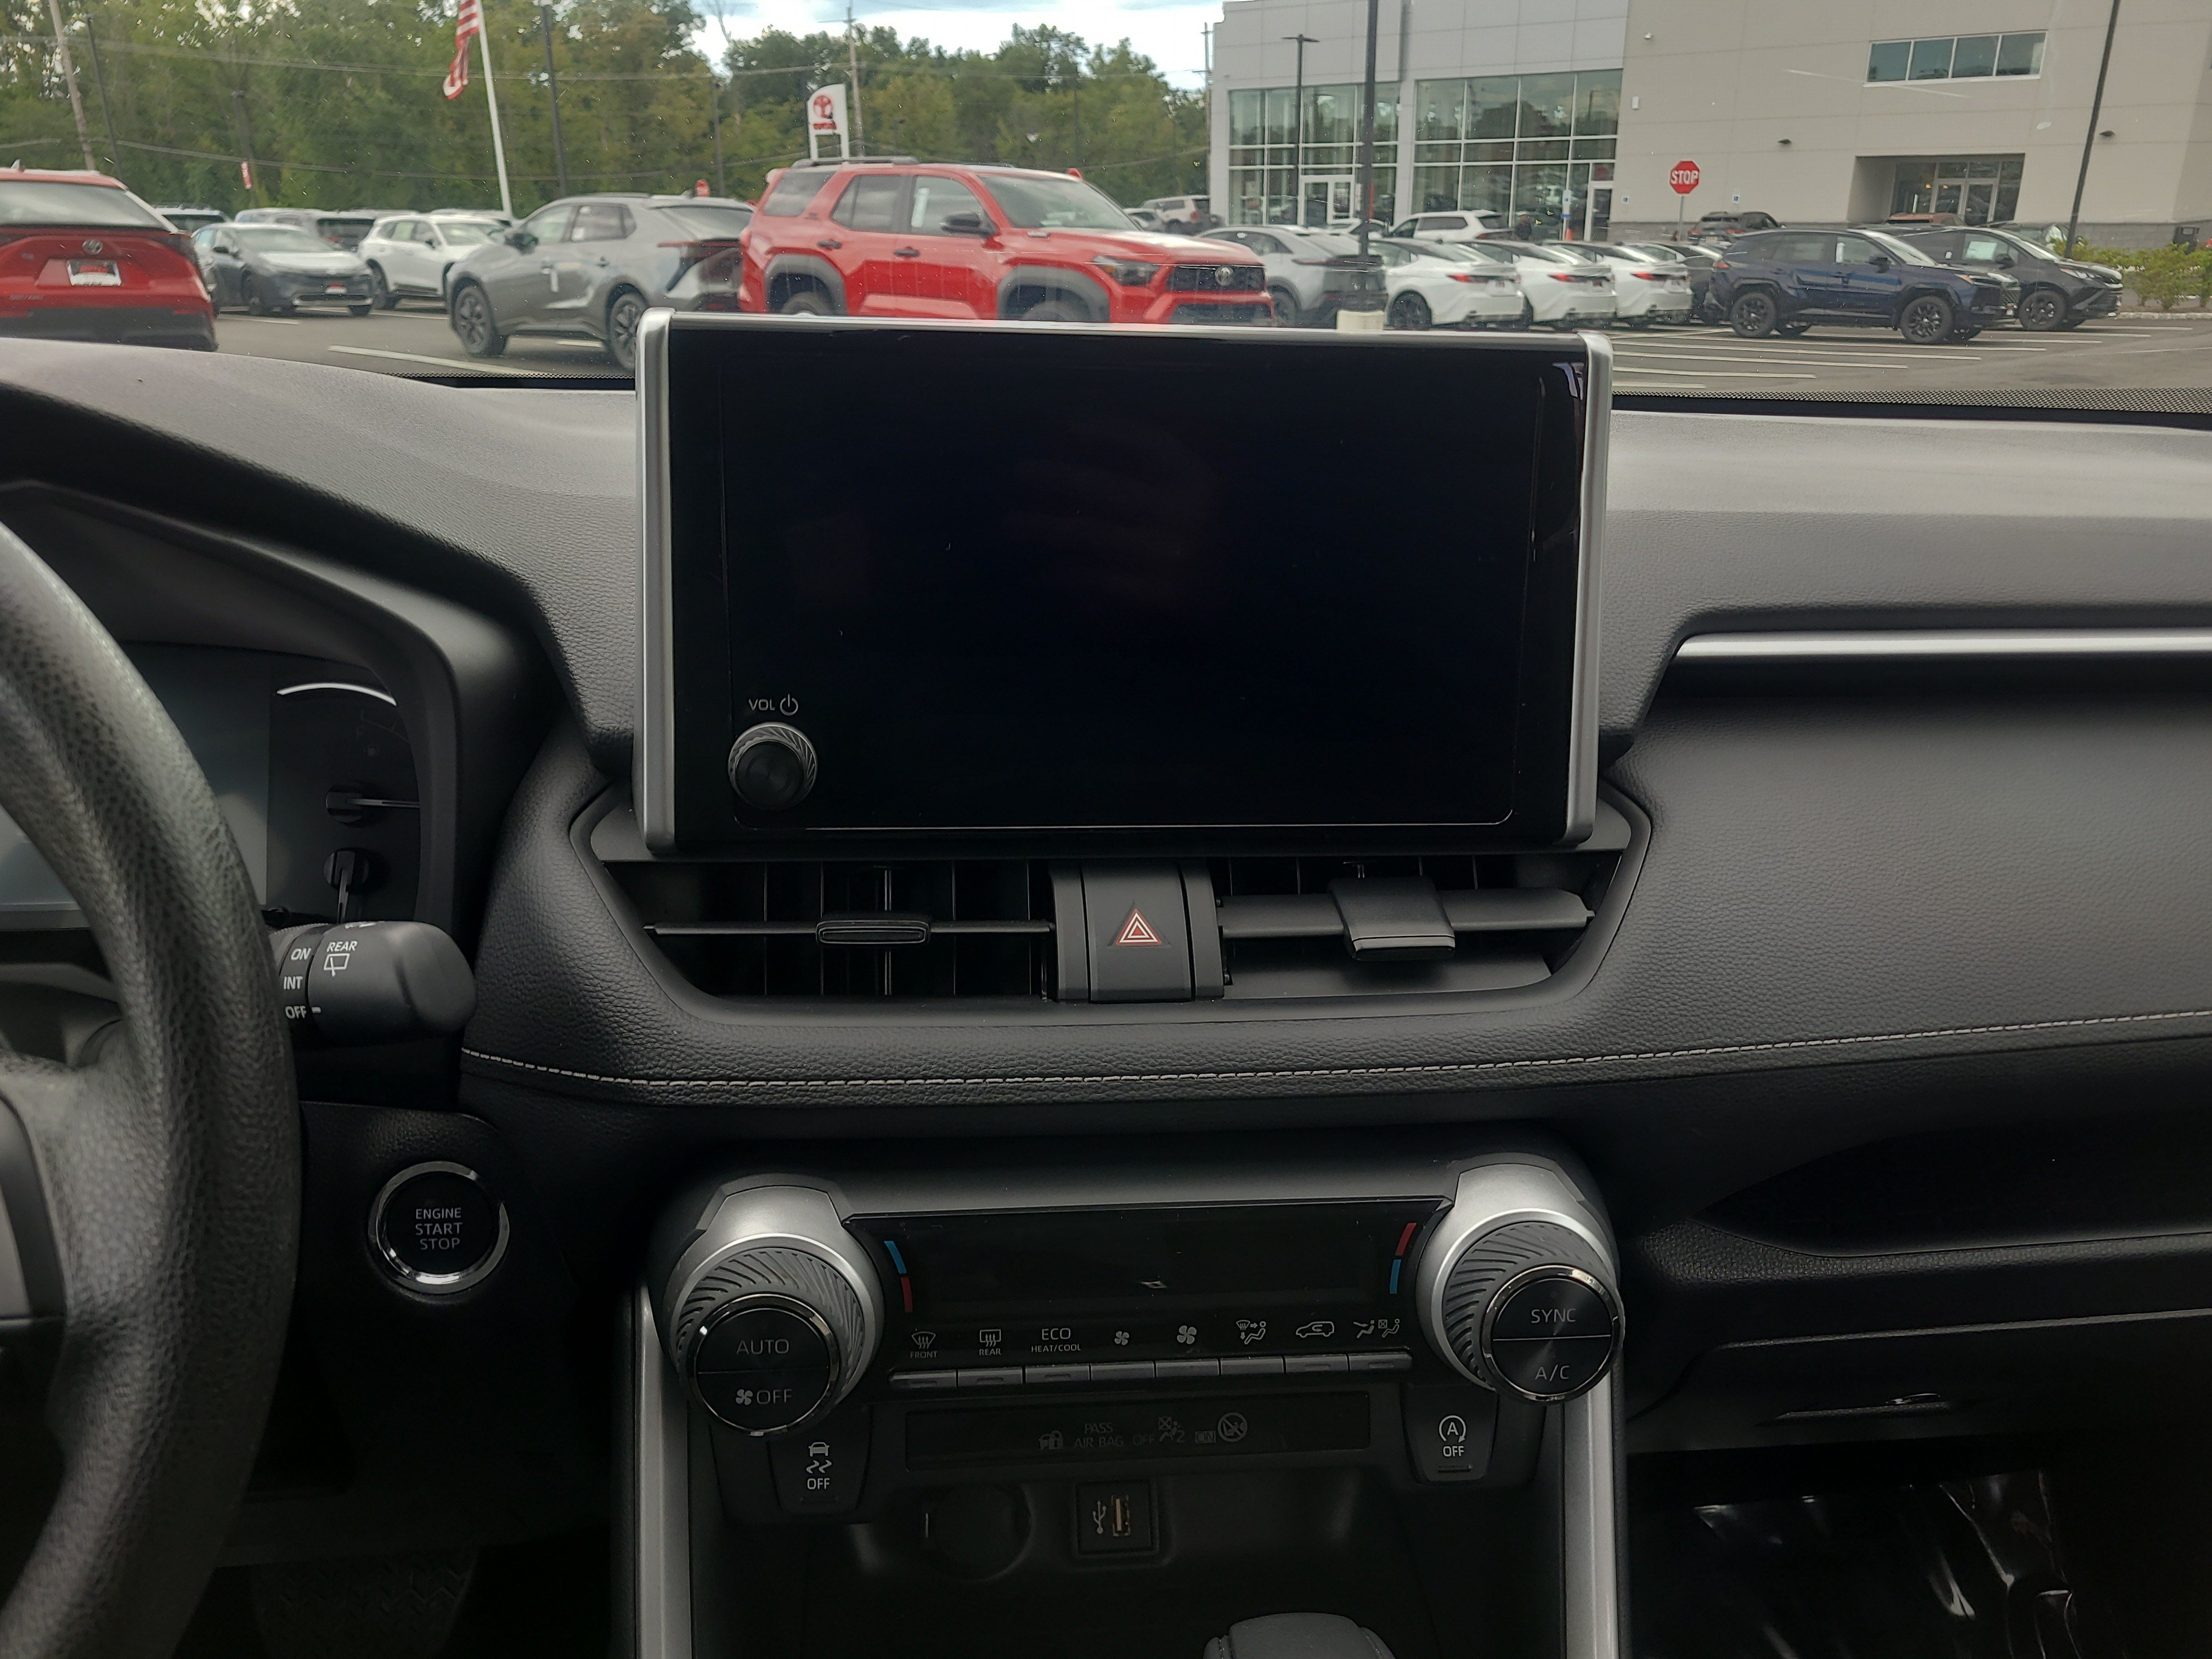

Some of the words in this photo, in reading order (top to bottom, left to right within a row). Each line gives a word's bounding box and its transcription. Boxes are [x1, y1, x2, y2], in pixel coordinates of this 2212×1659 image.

[1671, 170, 1699, 184] STOP
[748, 698, 775, 710] VOL
[326, 940, 358, 952] REAR
[291, 947, 311, 960] ON
[283, 976, 303, 990] INT
[285, 1005, 307, 1019] OFF
[416, 1207, 461, 1220] ENGINE
[415, 1222, 462, 1235] START
[420, 1237, 460, 1251] STOP
[1531, 1309, 1576, 1323] SYNC
[1042, 1328, 1071, 1340] ECO
[736, 1339, 789, 1355] AUTO
[979, 1348, 1001, 1356] REAR
[1031, 1344, 1081, 1353] HEAT/COOL
[910, 1350, 938, 1359] FRONT
[1535, 1365, 1570, 1382] A/C
[757, 1389, 792, 1405] OFF
[1084, 1422, 1114, 1434] PASS
[1074, 1437, 1094, 1449] AIR
[1098, 1436, 1124, 1448] BAG
[1132, 1434, 1156, 1446] OFF
[1443, 1446, 1464, 1457] OFF
[807, 1478, 830, 1489] OFF
